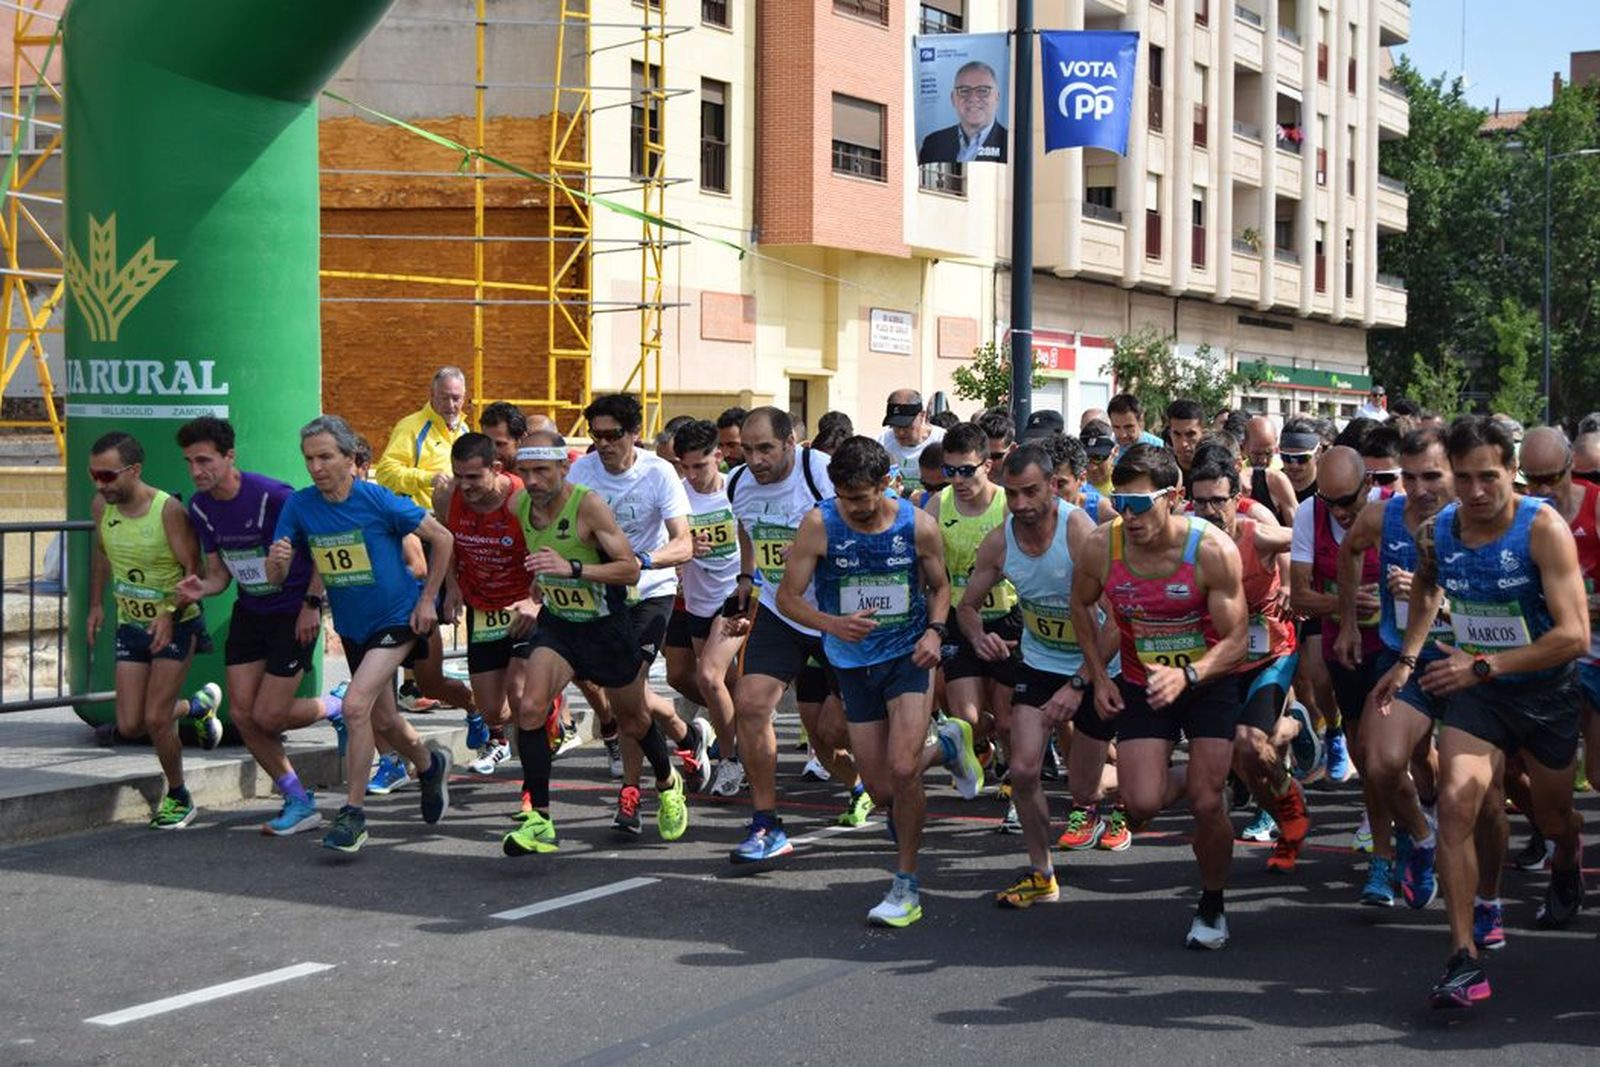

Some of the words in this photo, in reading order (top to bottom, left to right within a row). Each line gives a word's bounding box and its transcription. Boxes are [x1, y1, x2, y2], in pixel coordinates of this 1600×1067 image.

[1059, 61, 1118, 78] VOTA
[325, 549, 353, 570] 18
[544, 587, 585, 607] 104
[1036, 617, 1066, 639] 67
[1467, 626, 1517, 641] MARCOS
